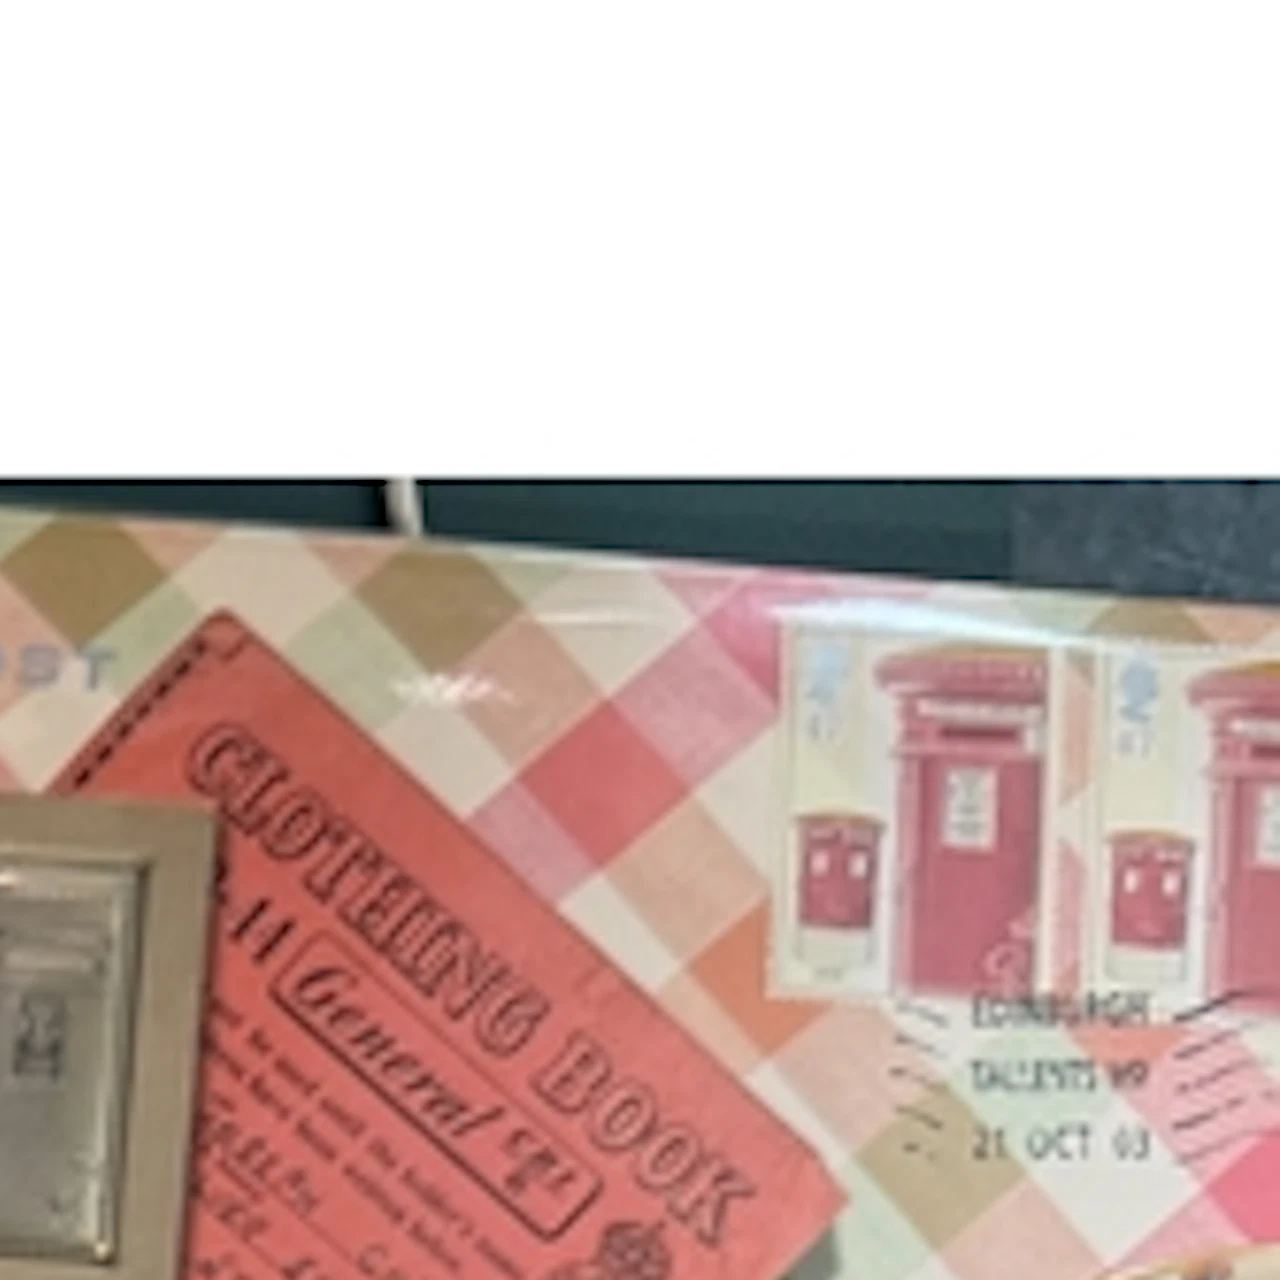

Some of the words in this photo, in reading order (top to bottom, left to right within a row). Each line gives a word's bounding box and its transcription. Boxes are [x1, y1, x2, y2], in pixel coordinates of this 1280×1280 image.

[185, 721, 552, 1059] CLOTHING
[530, 1027, 758, 1250] BOOK
[293, 961, 507, 1140] General
[971, 1123, 1008, 1162] 21
[1025, 1120, 1092, 1162] OCT
